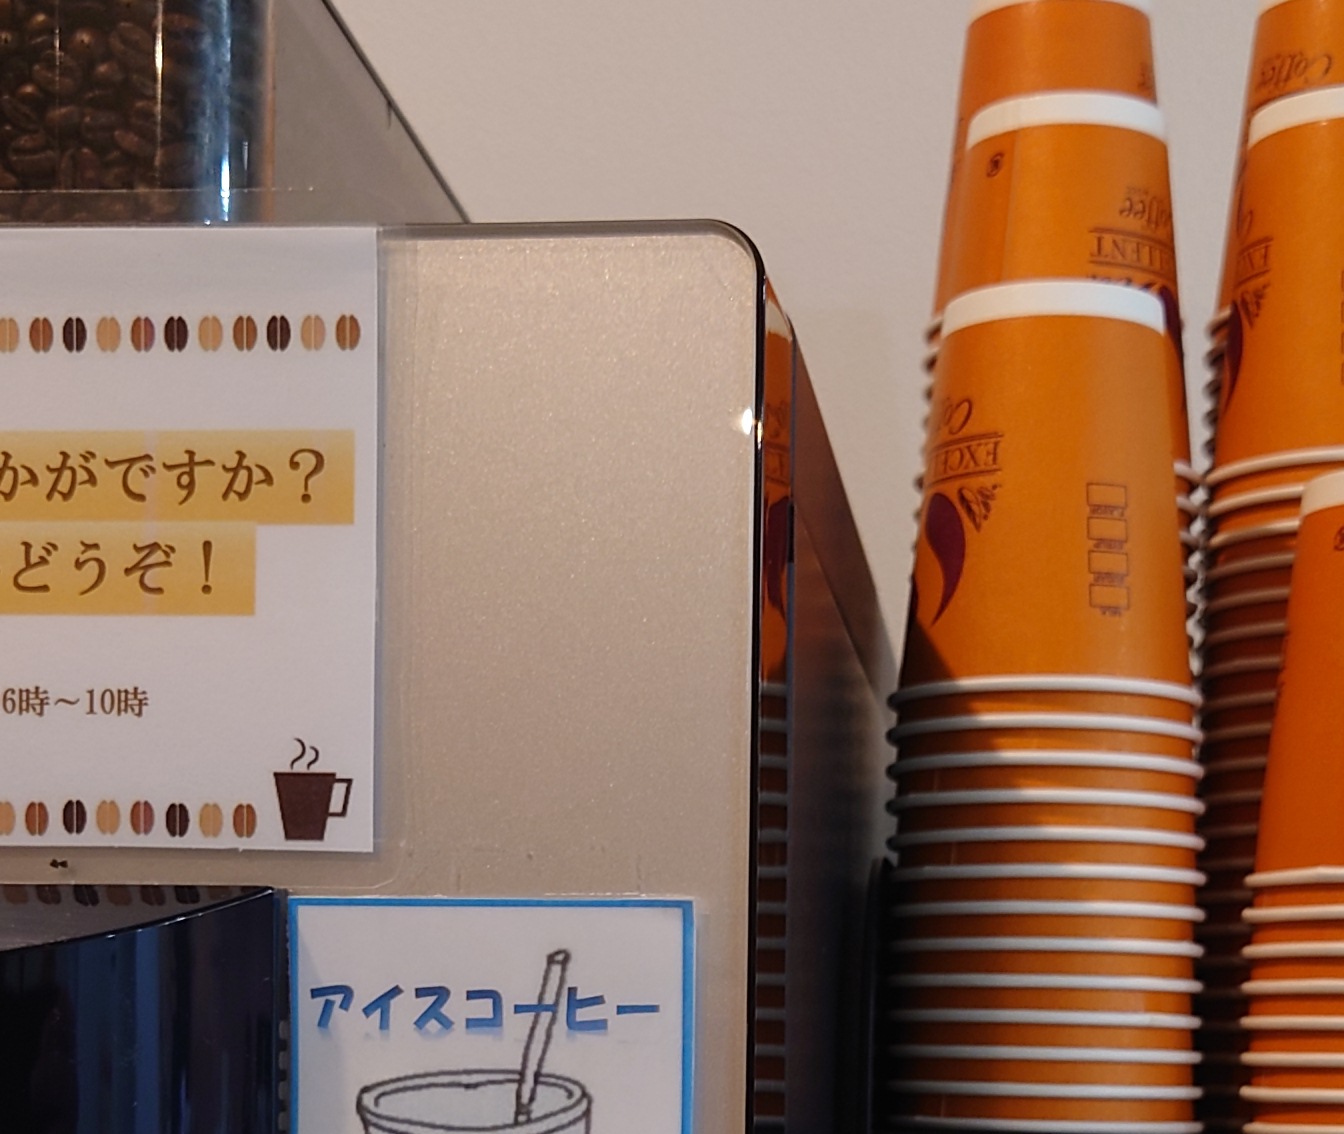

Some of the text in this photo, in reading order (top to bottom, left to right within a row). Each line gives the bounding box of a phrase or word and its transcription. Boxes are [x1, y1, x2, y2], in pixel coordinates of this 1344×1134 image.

[310, 985, 661, 1032] アイスコーヒー
